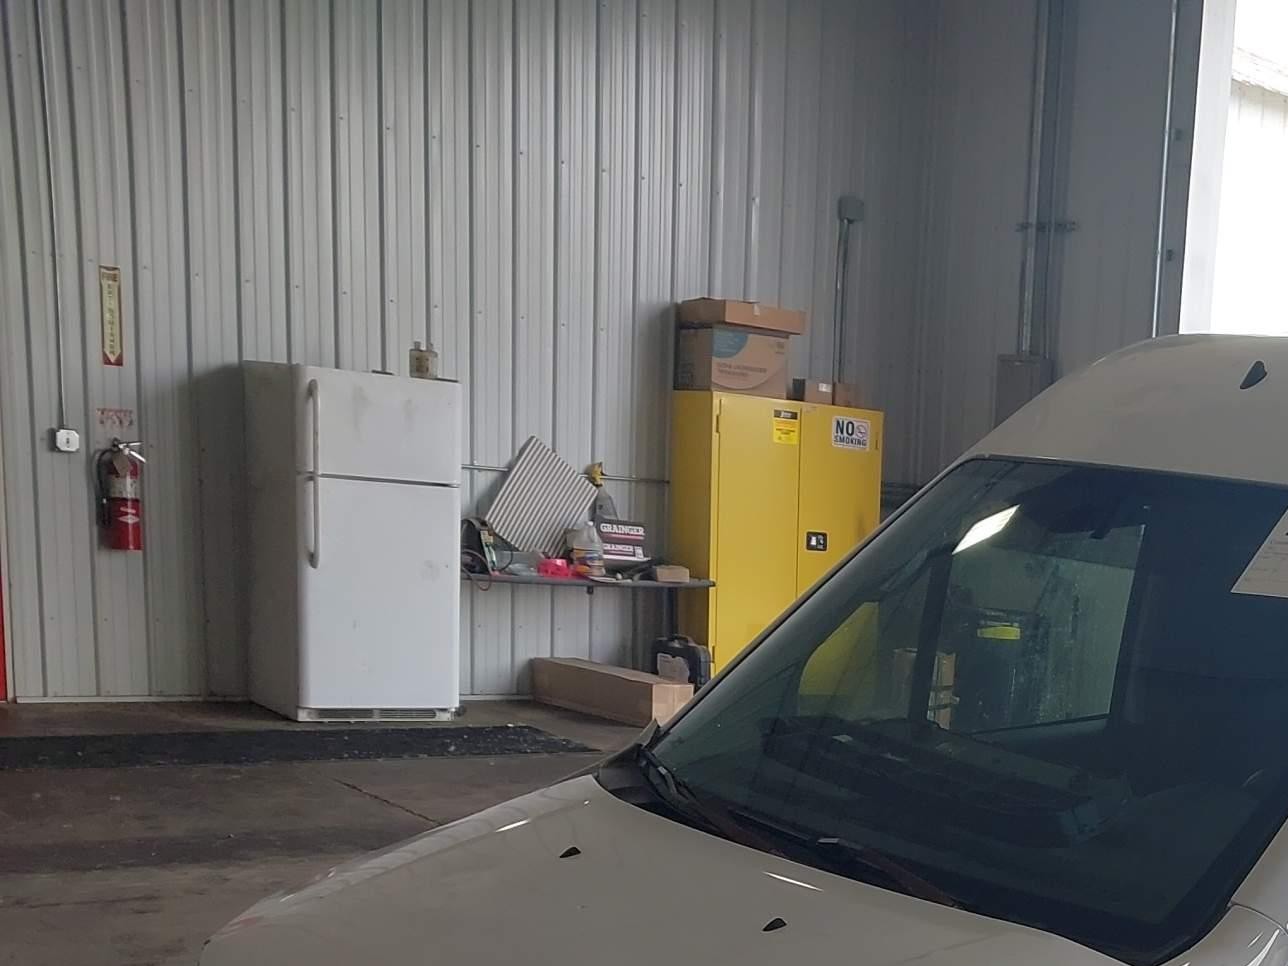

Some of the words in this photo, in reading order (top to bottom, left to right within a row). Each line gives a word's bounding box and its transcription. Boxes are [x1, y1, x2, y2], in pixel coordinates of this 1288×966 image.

[835, 419, 855, 436] NO
[833, 435, 868, 447] SMOKING
[600, 523, 645, 536] GRAINGER
